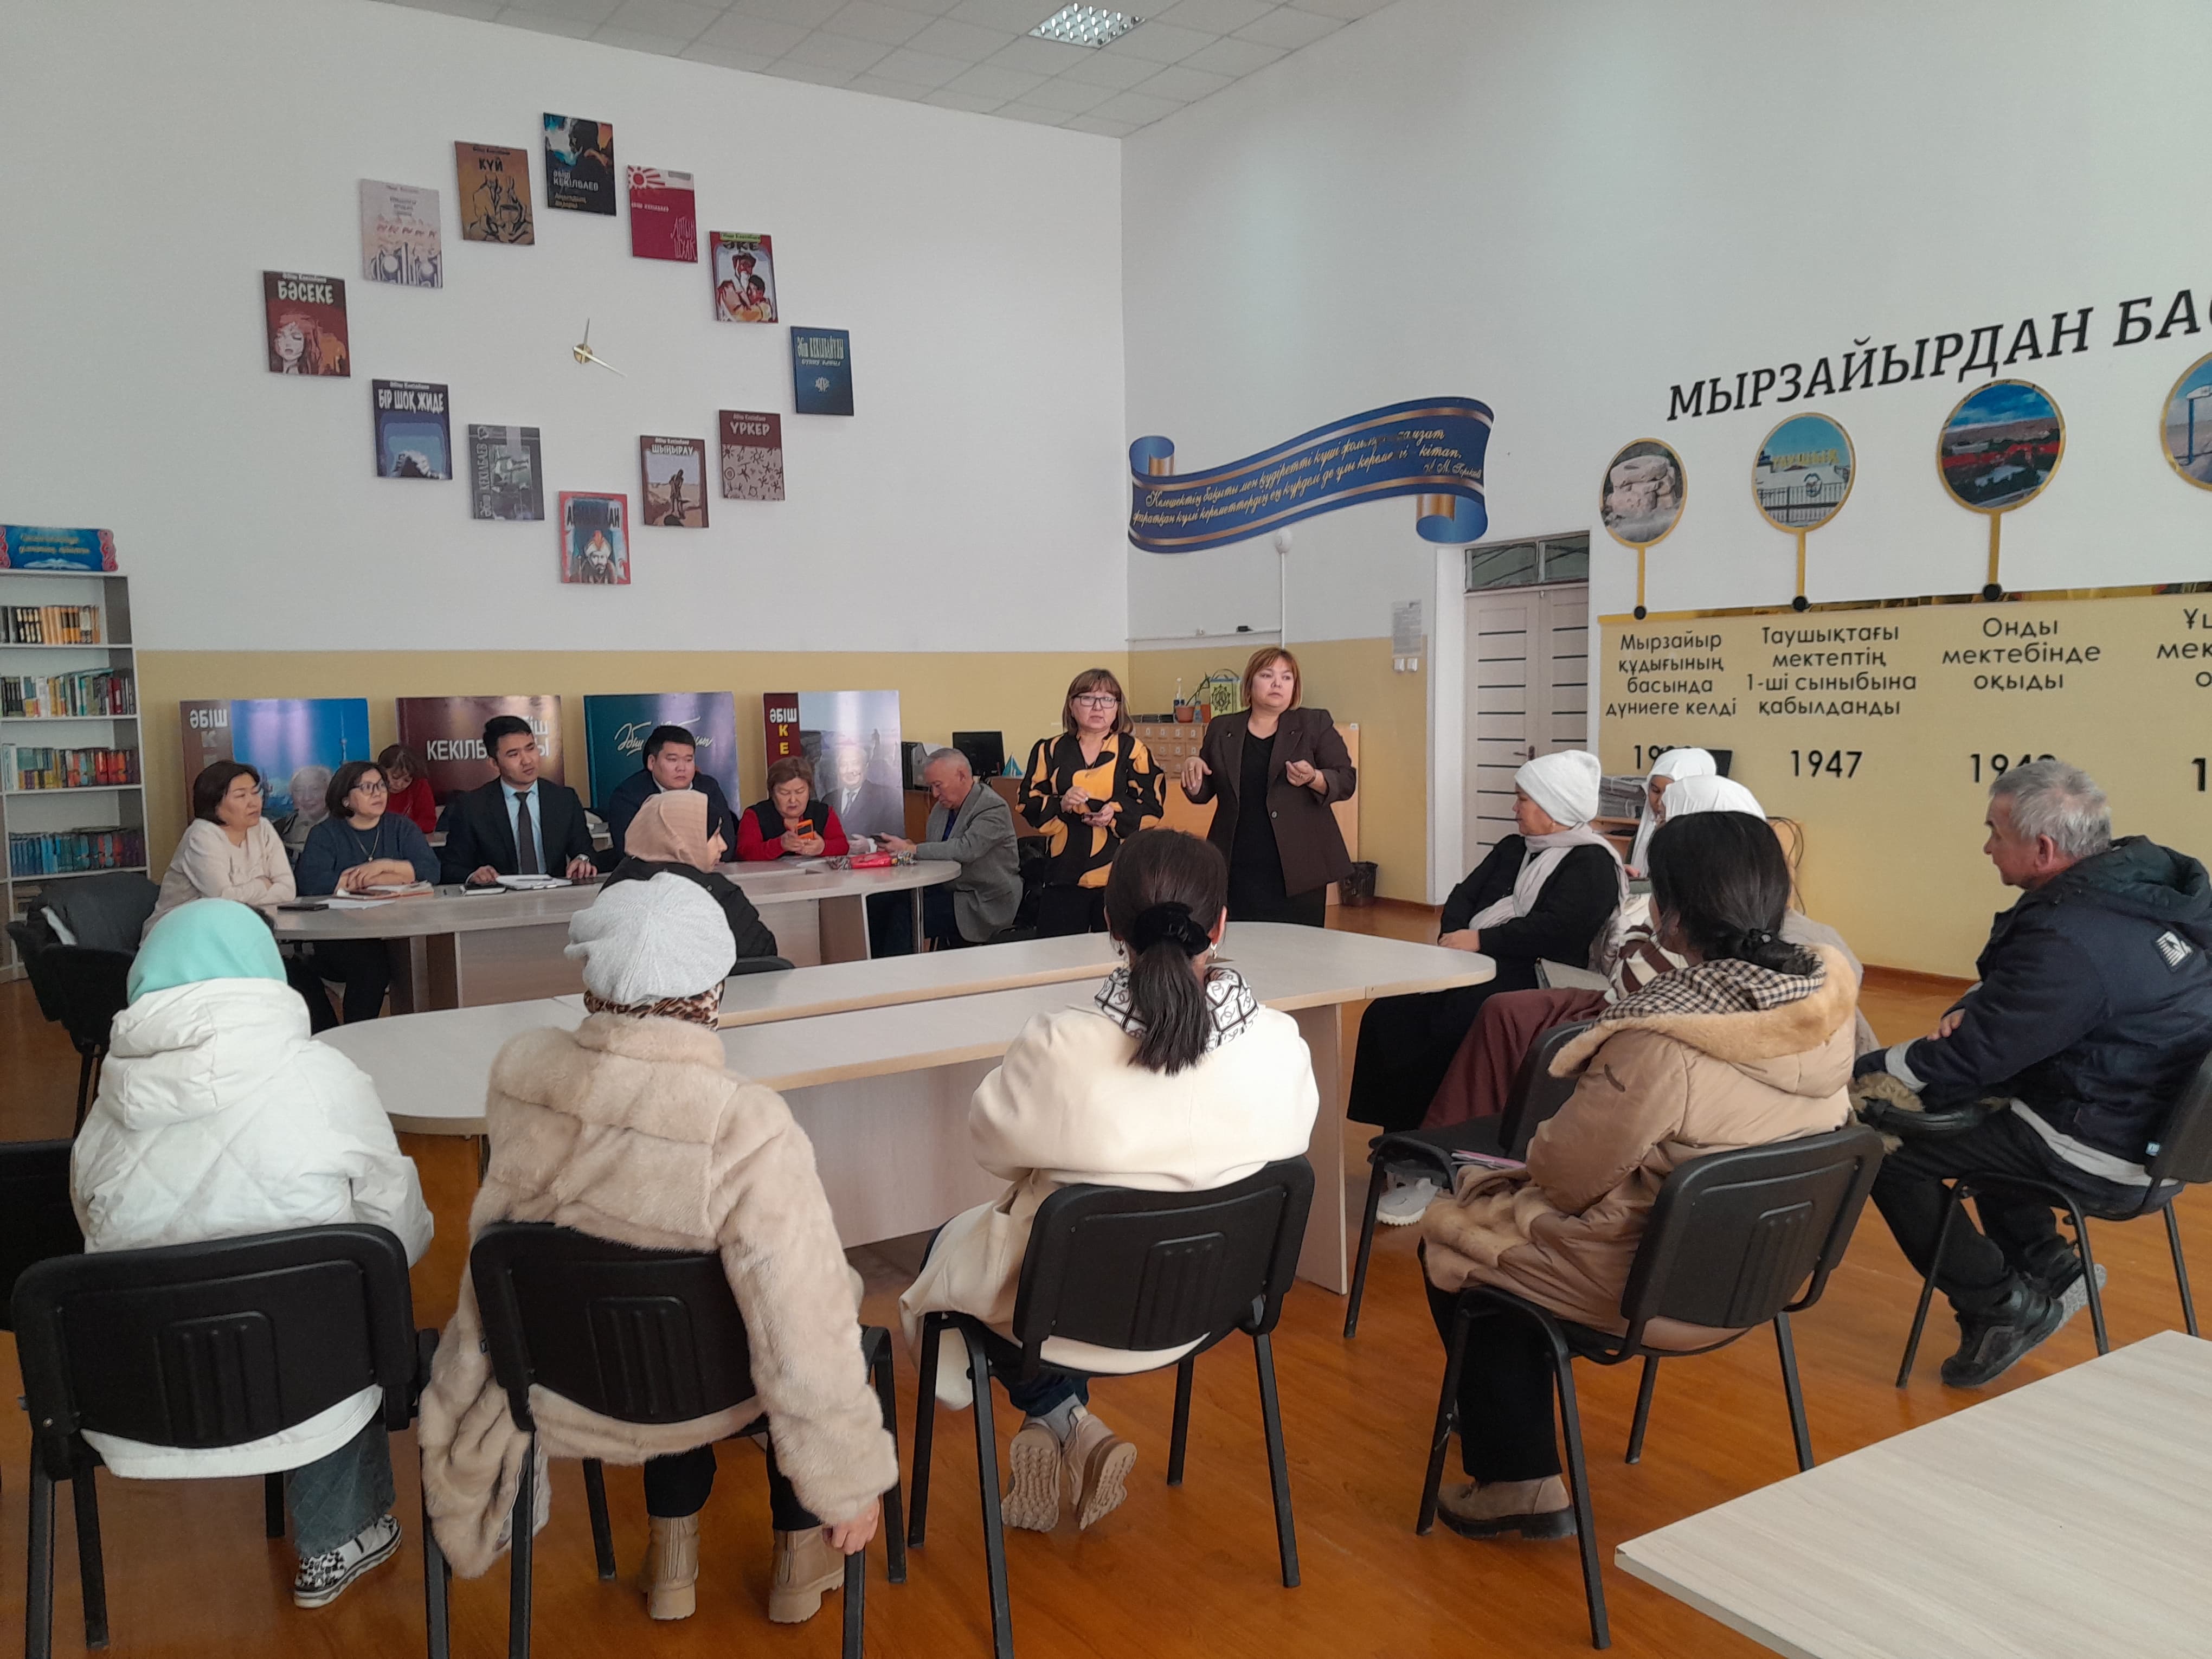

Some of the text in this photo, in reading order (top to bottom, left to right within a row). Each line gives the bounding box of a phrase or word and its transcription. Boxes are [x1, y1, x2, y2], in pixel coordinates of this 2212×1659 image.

[277, 280, 335, 305] БӘСЕКЕ
[1667, 289, 2212, 421] МЫРЗАЙЫРДАН БА
[378, 388, 444, 414] БІР ШОҚ ЖИДЕ
[730, 421, 770, 436] ҮРКЕР
[652, 444, 694, 455] ШЫҢЫРАУ
[1761, 626, 1899, 648] Таушықтағы
[1983, 617, 2058, 638] Онды
[1620, 631, 1722, 654] Мырзайыр
[1942, 641, 2101, 665] мектебінде
[1618, 656, 1724, 676] құдығының
[1772, 646, 1887, 668] мектептің
[1627, 676, 1713, 695] басында
[1747, 671, 1917, 691] 1-ші сыныбына
[1973, 674, 2063, 692] оқыды
[769, 708, 798, 724] ӘБІШ
[1605, 697, 1737, 719] дүниеге келді
[1758, 696, 1900, 717] қабылданды
[190, 708, 228, 729] ӘБІШ
[1790, 749, 1863, 779] 1947
